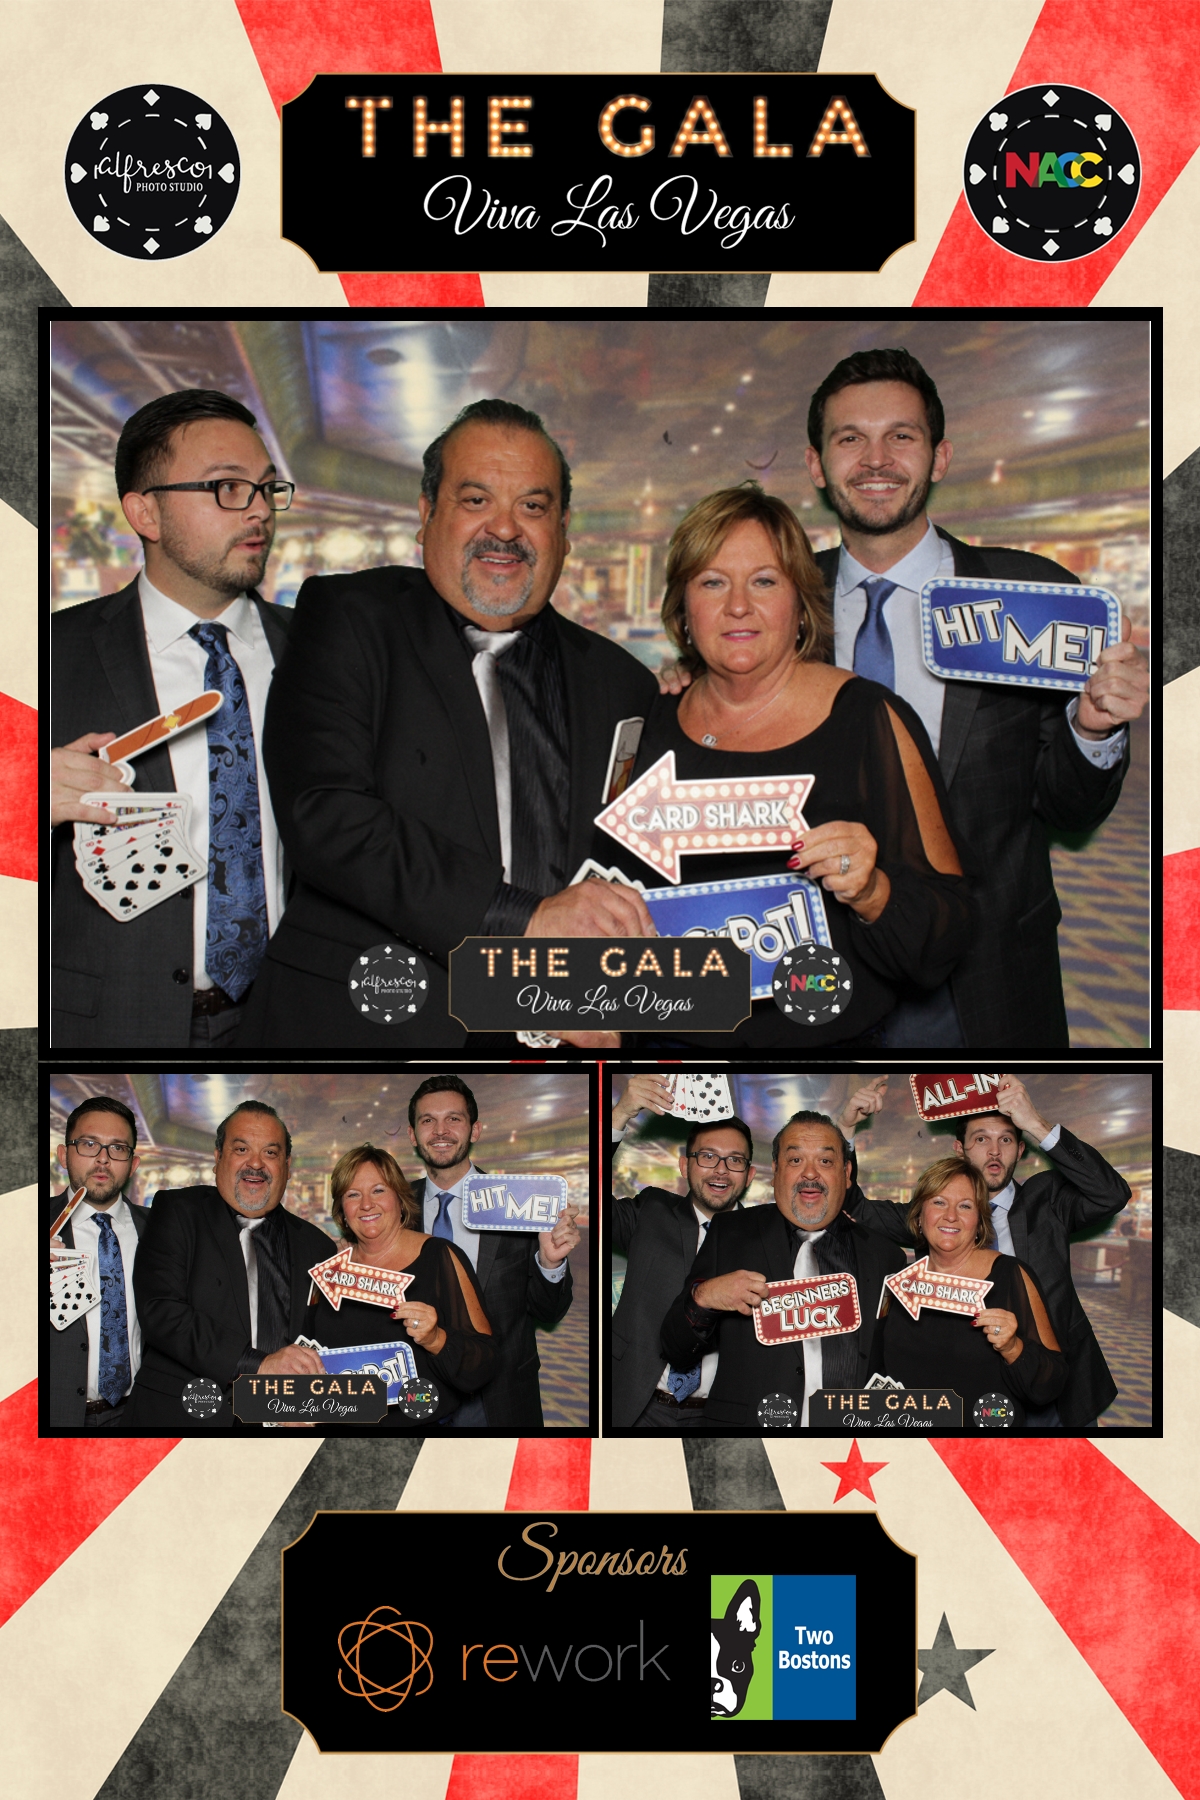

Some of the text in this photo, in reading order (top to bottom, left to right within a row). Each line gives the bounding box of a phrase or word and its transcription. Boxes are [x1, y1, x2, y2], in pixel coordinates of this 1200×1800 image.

[932, 598, 1107, 676] HIT ME!
[627, 800, 789, 832] CARD SHARK
[469, 1184, 560, 1224] HIT ME!
[322, 1269, 399, 1297] CARD SHARK
[760, 1279, 851, 1317] BEGINNERS
[899, 1279, 979, 1304] CARD SHARK
[780, 1306, 843, 1332] LUCK
